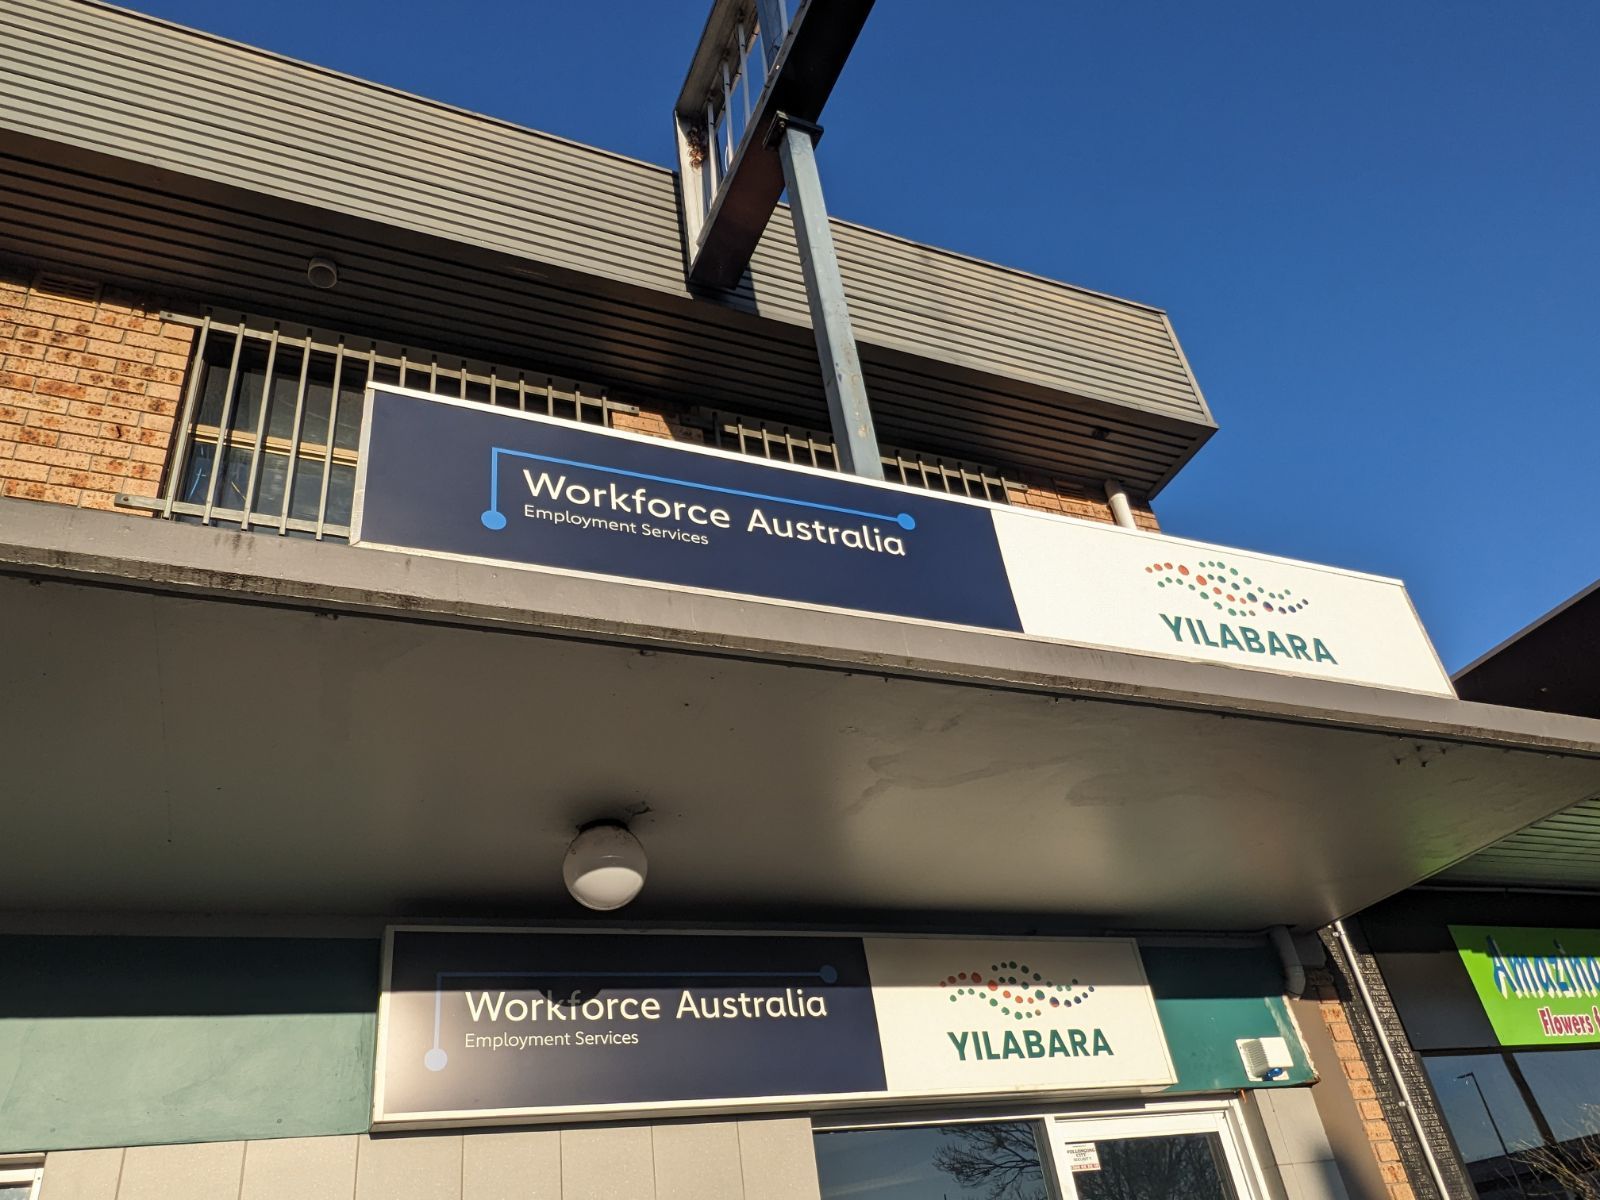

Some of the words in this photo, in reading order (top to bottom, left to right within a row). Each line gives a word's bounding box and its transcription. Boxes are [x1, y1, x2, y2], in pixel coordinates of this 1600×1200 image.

[522, 468, 731, 529] Workforce
[746, 508, 907, 557] Australia
[523, 503, 638, 535] Employment
[640, 523, 710, 546] Services
[1158, 613, 1339, 665] YILABARA
[464, 989, 661, 1022] Workforce
[675, 988, 828, 1019] Australia
[1538, 1006, 1595, 1036] Flowers
[464, 1031, 571, 1051] Employment
[575, 1030, 639, 1046] Services
[946, 1027, 1115, 1061] YILABARA
